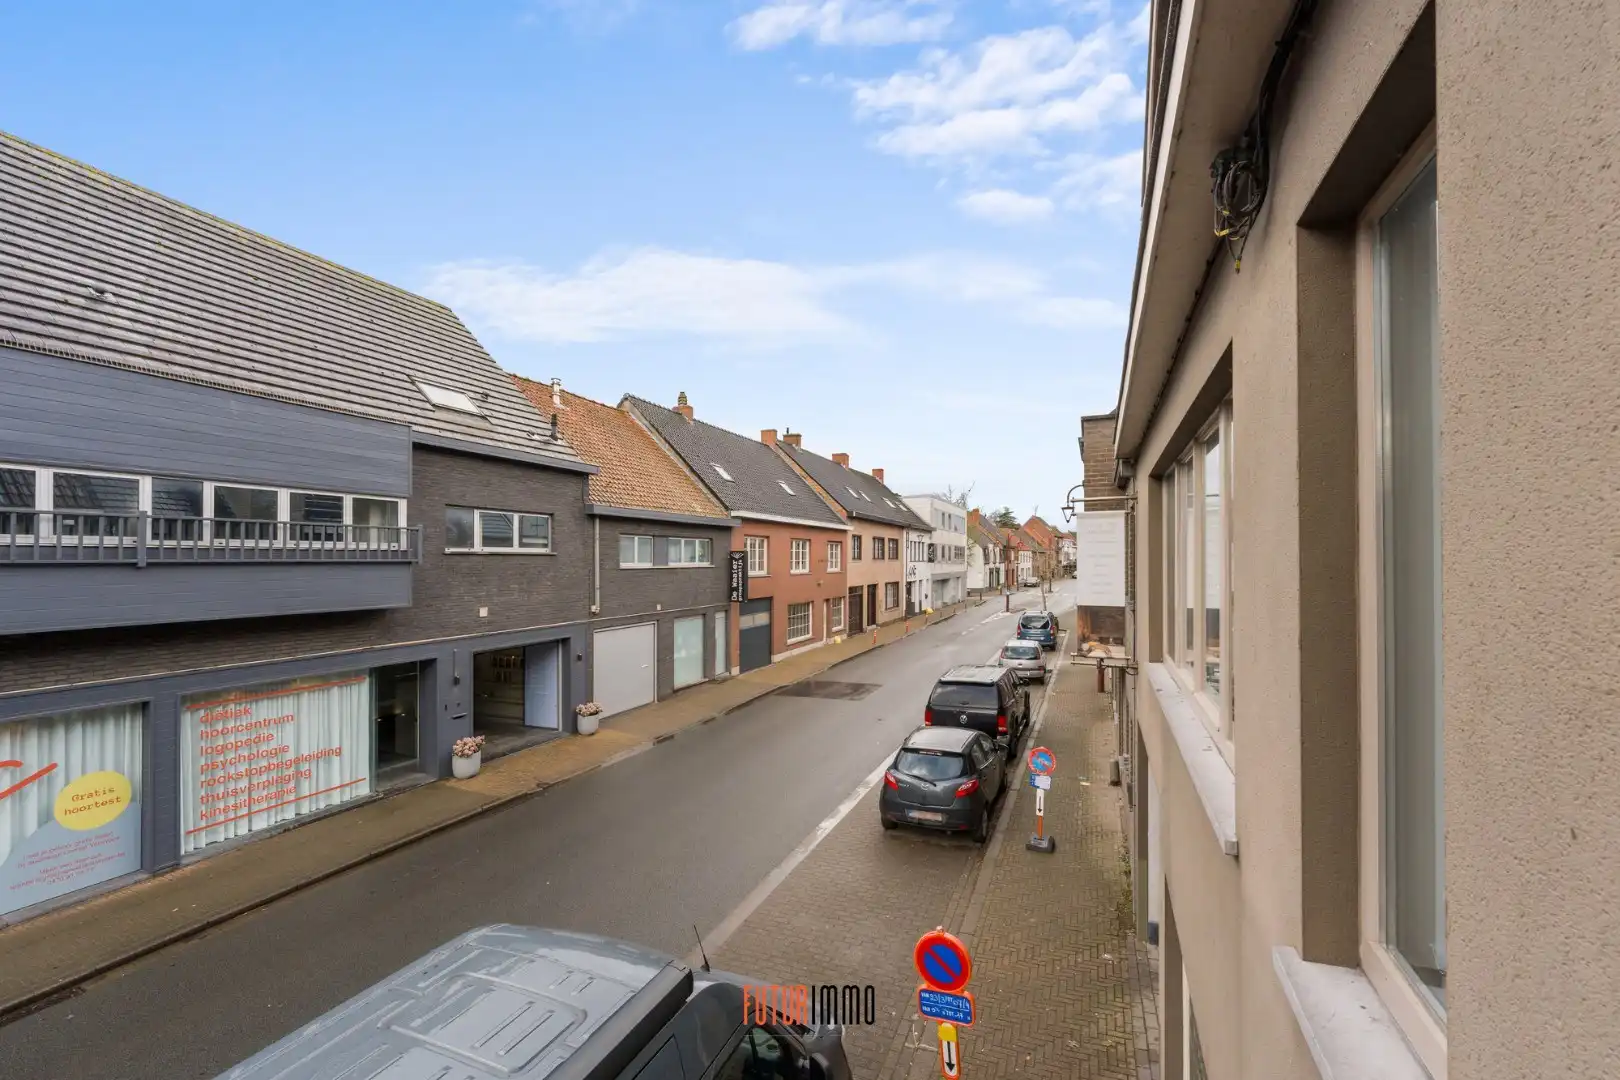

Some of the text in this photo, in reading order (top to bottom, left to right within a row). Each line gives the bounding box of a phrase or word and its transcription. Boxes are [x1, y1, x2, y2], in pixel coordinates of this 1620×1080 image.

[200, 713, 294, 740] hoorcentrum
[200, 732, 274, 757] logopedie
[200, 744, 290, 775] psychologie
[200, 746, 342, 789] rookstopbegeleiding
[71, 787, 116, 802] Gratis
[200, 768, 312, 805] thuisverpleging
[64, 795, 122, 816] hoortest
[200, 785, 297, 820] kinesitherapie
